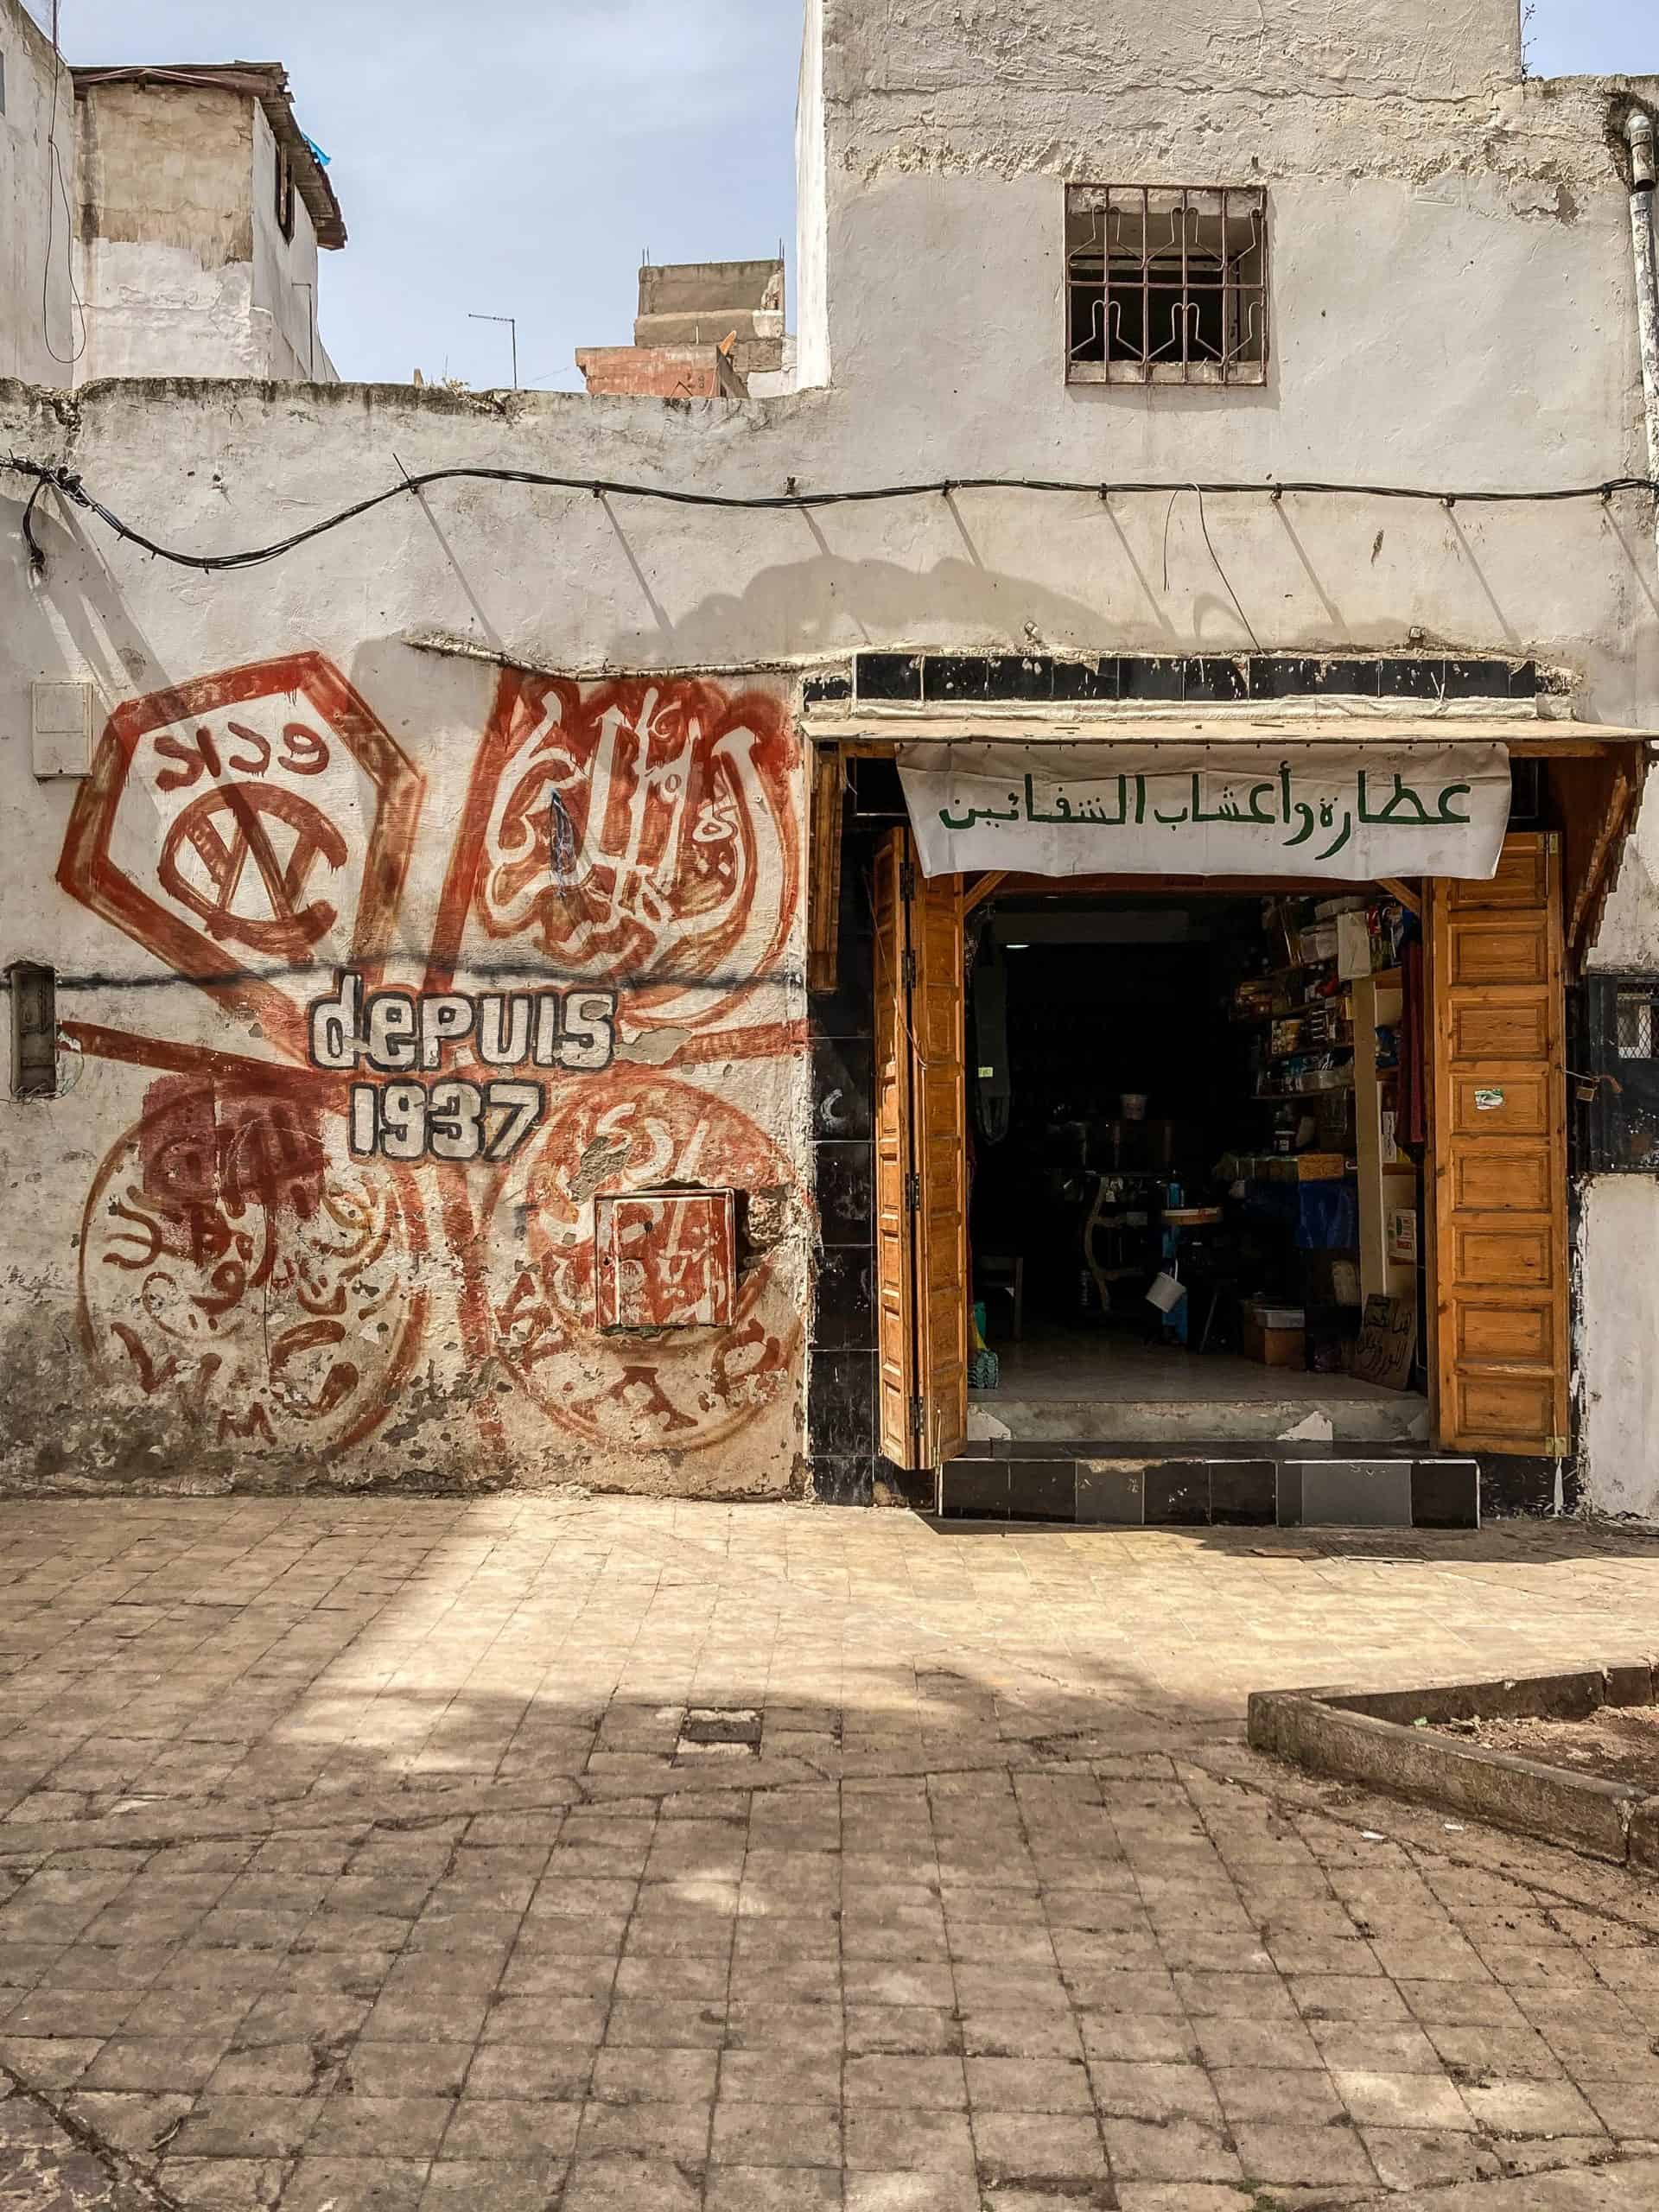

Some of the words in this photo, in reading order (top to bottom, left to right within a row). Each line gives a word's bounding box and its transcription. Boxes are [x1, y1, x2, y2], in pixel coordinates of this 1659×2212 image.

[1154, 760, 1314, 846] وأعشاب
[1314, 769, 1471, 860] عطارة
[349, 1079, 547, 1162] 1937
